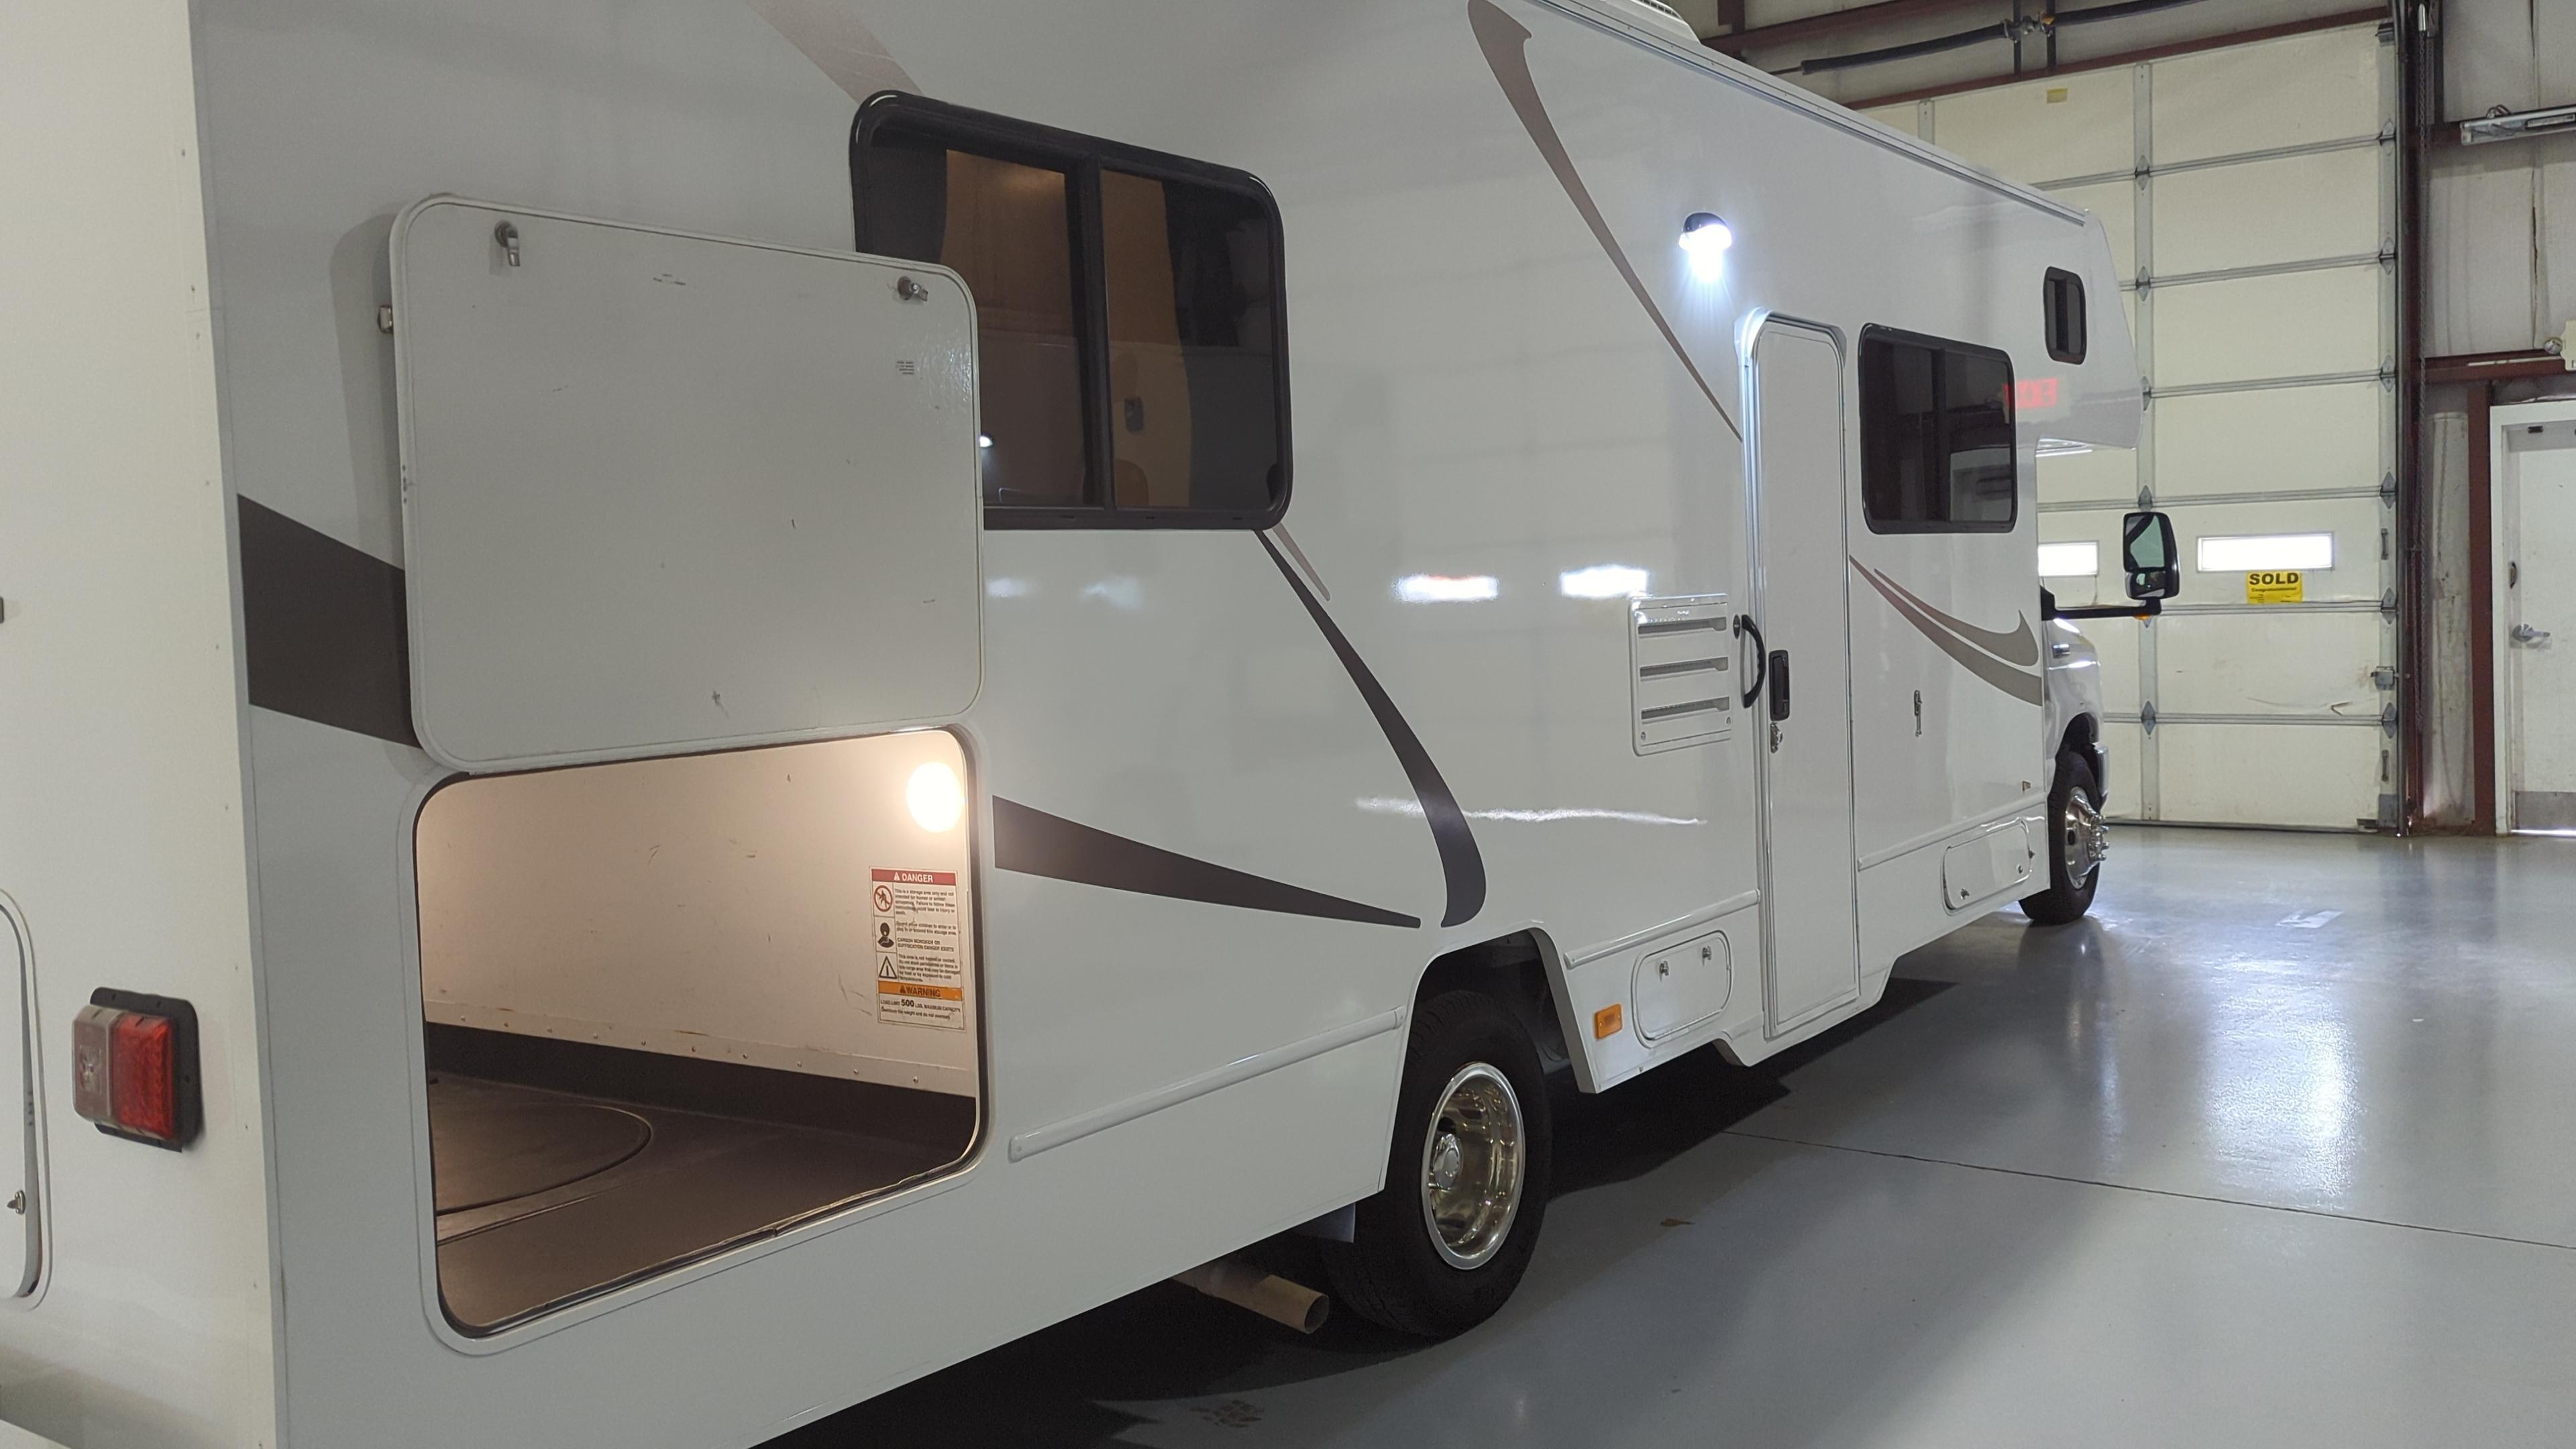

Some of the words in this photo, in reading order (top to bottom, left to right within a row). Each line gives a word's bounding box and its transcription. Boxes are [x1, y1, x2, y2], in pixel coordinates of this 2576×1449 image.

[2249, 572, 2299, 585] SOLD
[902, 873, 933, 883] DANGER
[906, 986, 941, 997] WARNING
[901, 999, 914, 1007] 500
